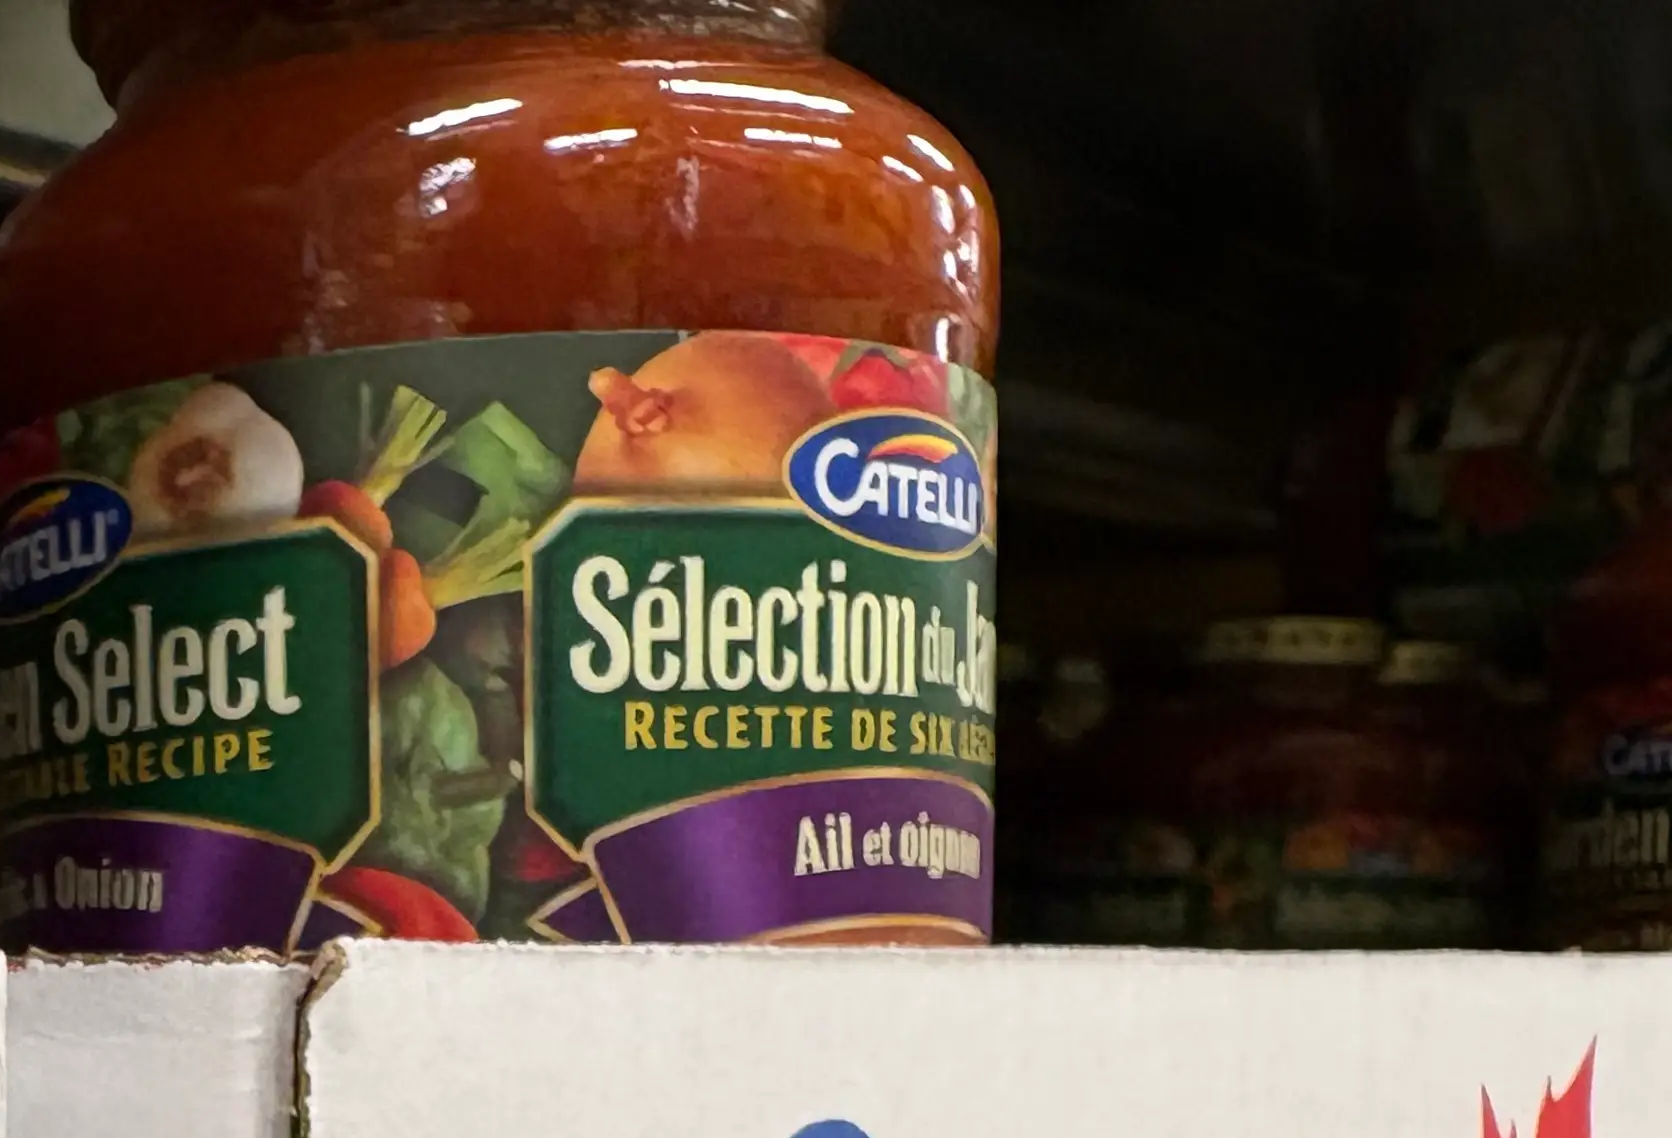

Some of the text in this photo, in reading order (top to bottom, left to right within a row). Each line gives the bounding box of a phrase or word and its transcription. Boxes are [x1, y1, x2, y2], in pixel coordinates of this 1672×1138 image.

[569, 555, 918, 697] Sélection
[53, 585, 301, 743] Select
[108, 729, 273, 786] RECIPE
[625, 701, 833, 751] RECETTE
[851, 709, 896, 753] DE
[910, 711, 955, 757] SIX
[794, 812, 853, 876] Ail
[863, 822, 894, 866] et
[54, 856, 163, 912] Onion
